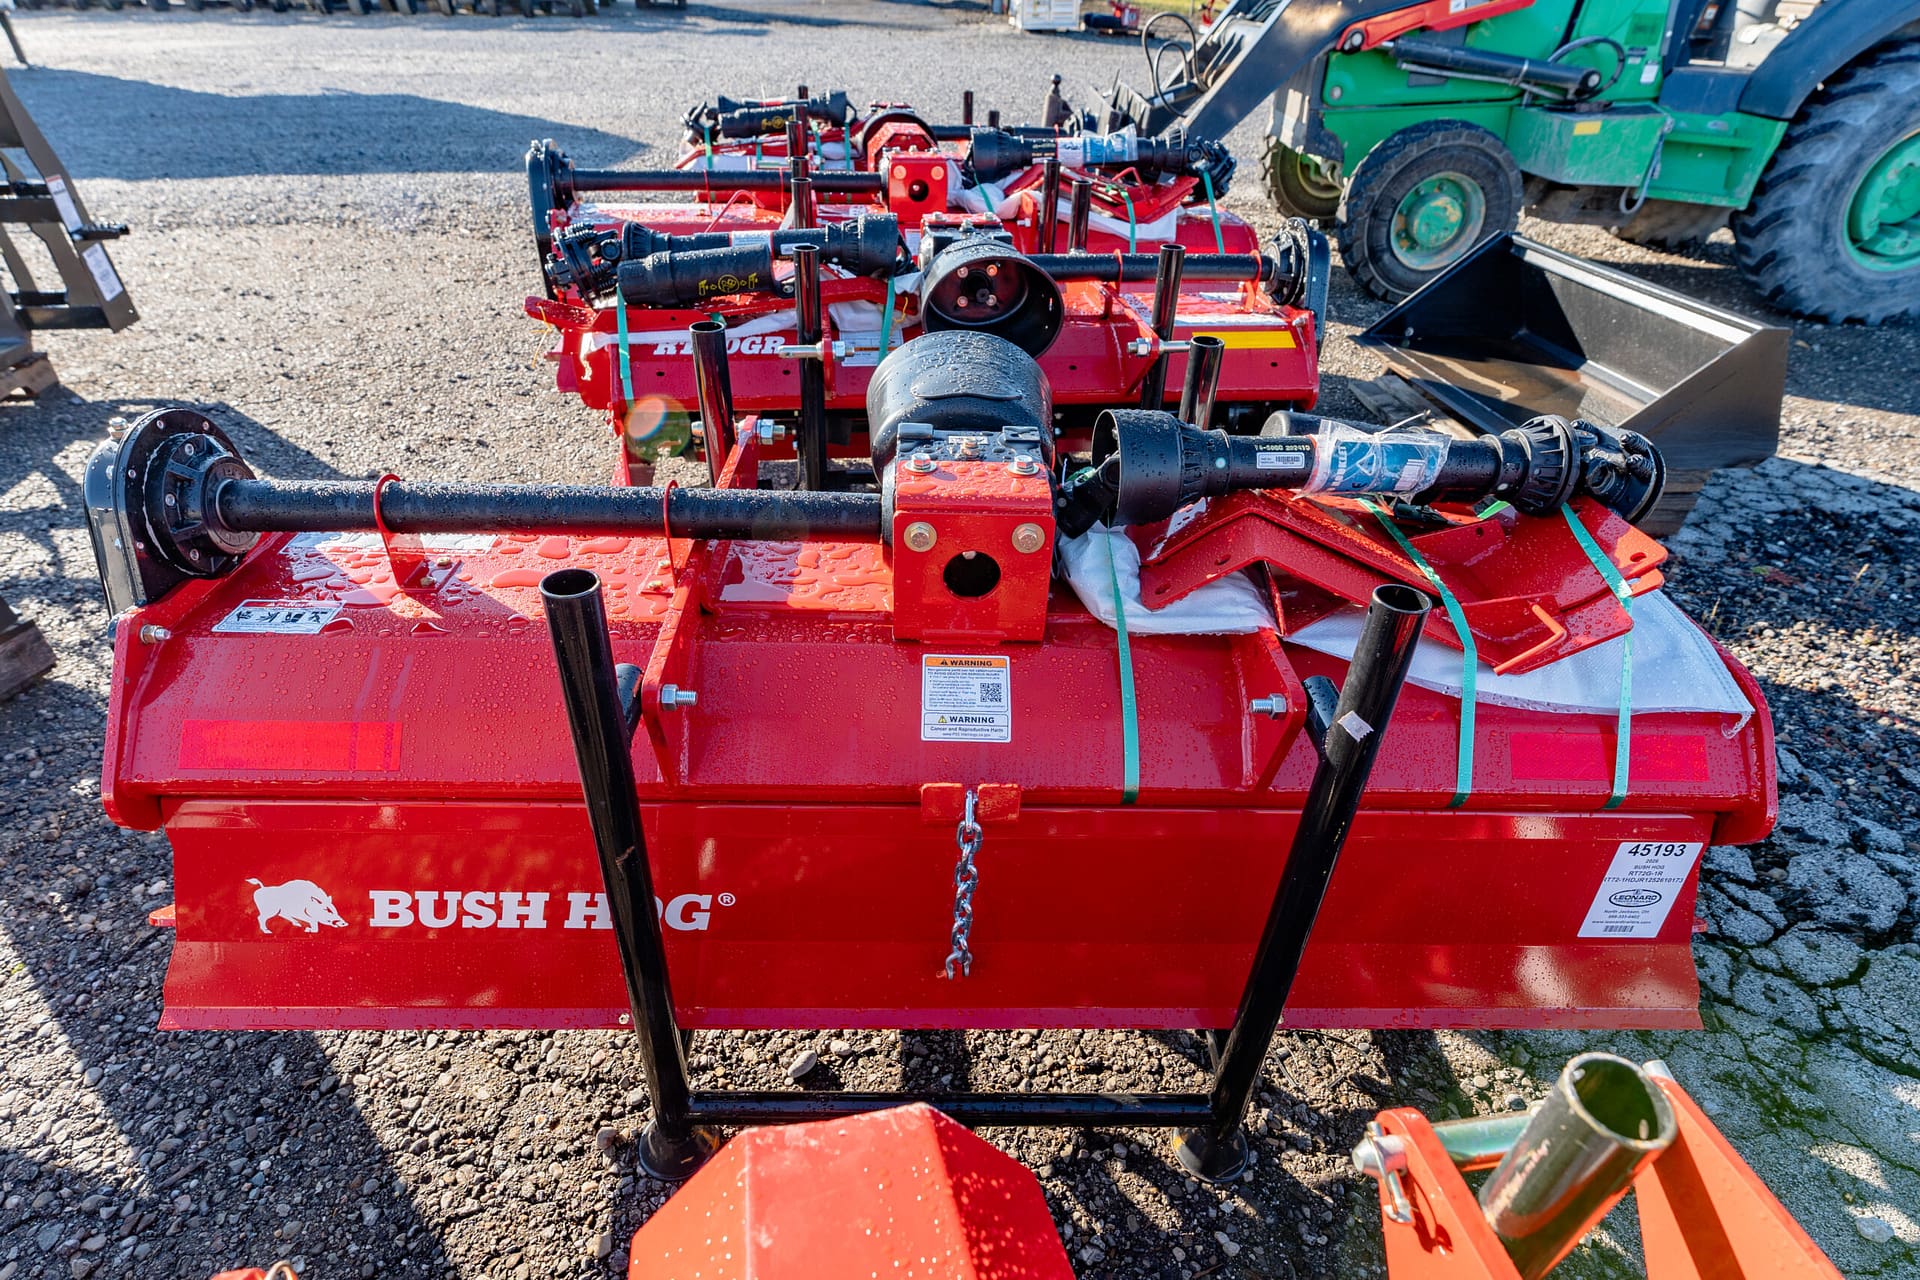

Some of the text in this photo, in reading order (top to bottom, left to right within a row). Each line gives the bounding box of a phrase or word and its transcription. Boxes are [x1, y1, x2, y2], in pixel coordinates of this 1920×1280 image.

[653, 336, 785, 355] RT0GR
[949, 716, 995, 724] WARNING
[1628, 843, 1687, 857] 45193
[369, 890, 713, 931] BUSH HG
